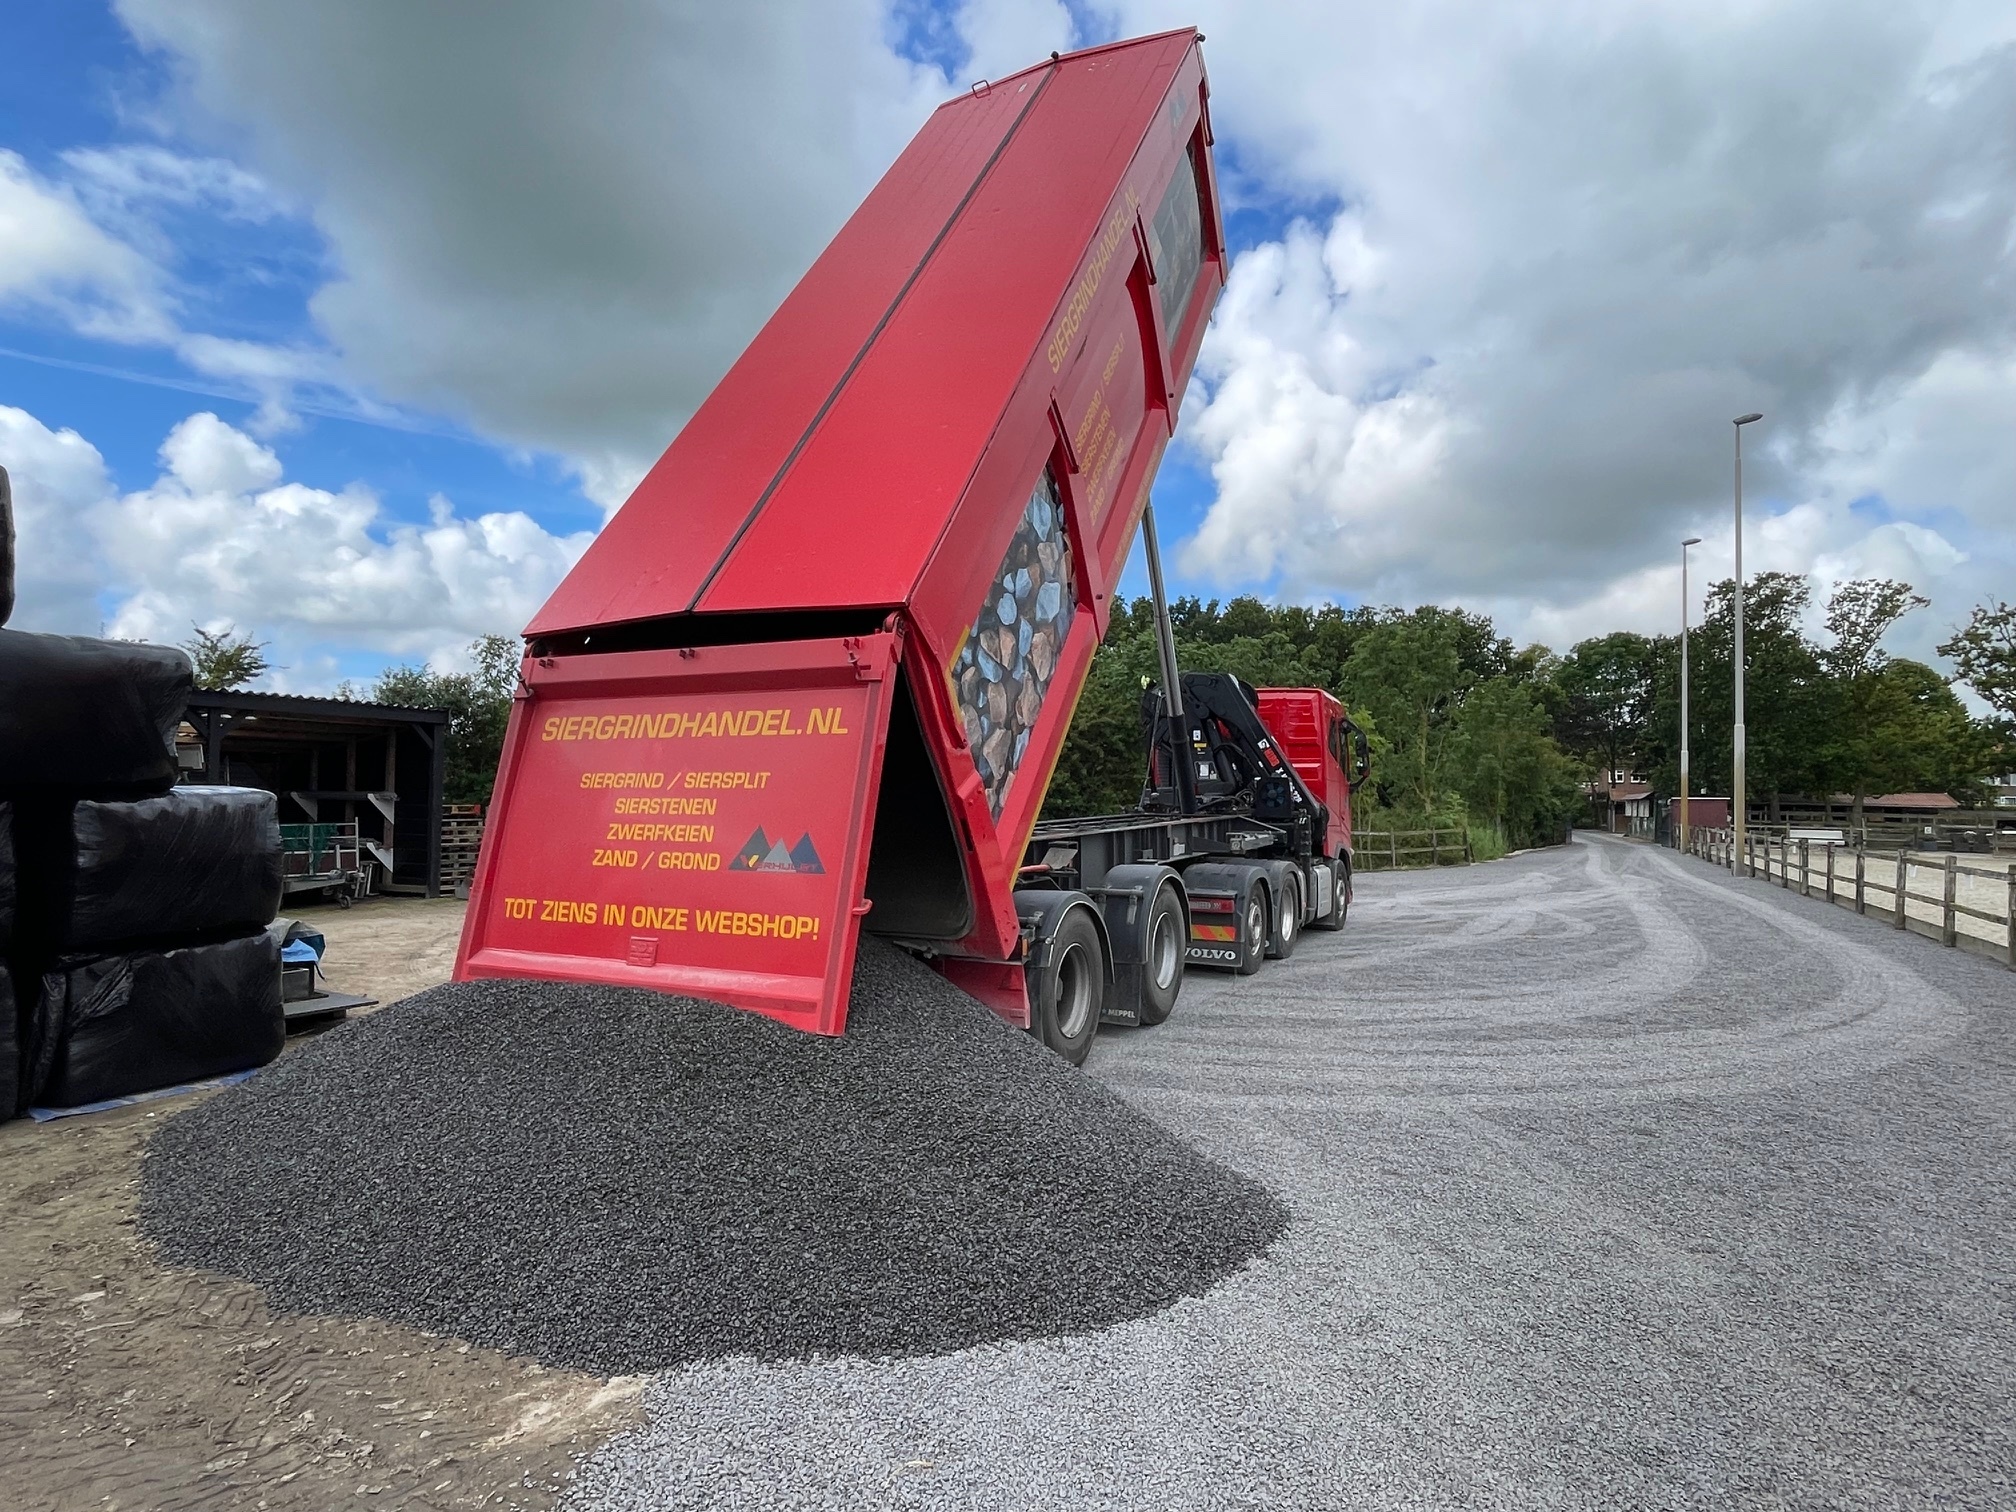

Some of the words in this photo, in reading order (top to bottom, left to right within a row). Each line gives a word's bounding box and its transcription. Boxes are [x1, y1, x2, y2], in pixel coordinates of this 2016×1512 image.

[1048, 183, 1140, 374] SIERGRINDHANDEL.NL
[541, 707, 848, 741] SIERGRINDHANDEL.NL
[580, 773, 664, 789] SIERGRIND
[667, 772, 682, 791] /
[684, 772, 771, 789] SIERSPLIT
[614, 798, 717, 815] SIERSTENEN
[607, 823, 714, 842] ZWERFKEIEN
[592, 849, 638, 867] ZAND
[641, 851, 655, 870] /
[658, 852, 721, 871] GROND
[504, 897, 537, 919] TOT
[540, 900, 597, 924] ZIENS
[603, 904, 626, 926] IN
[631, 906, 689, 931] ONZE
[695, 909, 819, 941] WEBSHOP!
